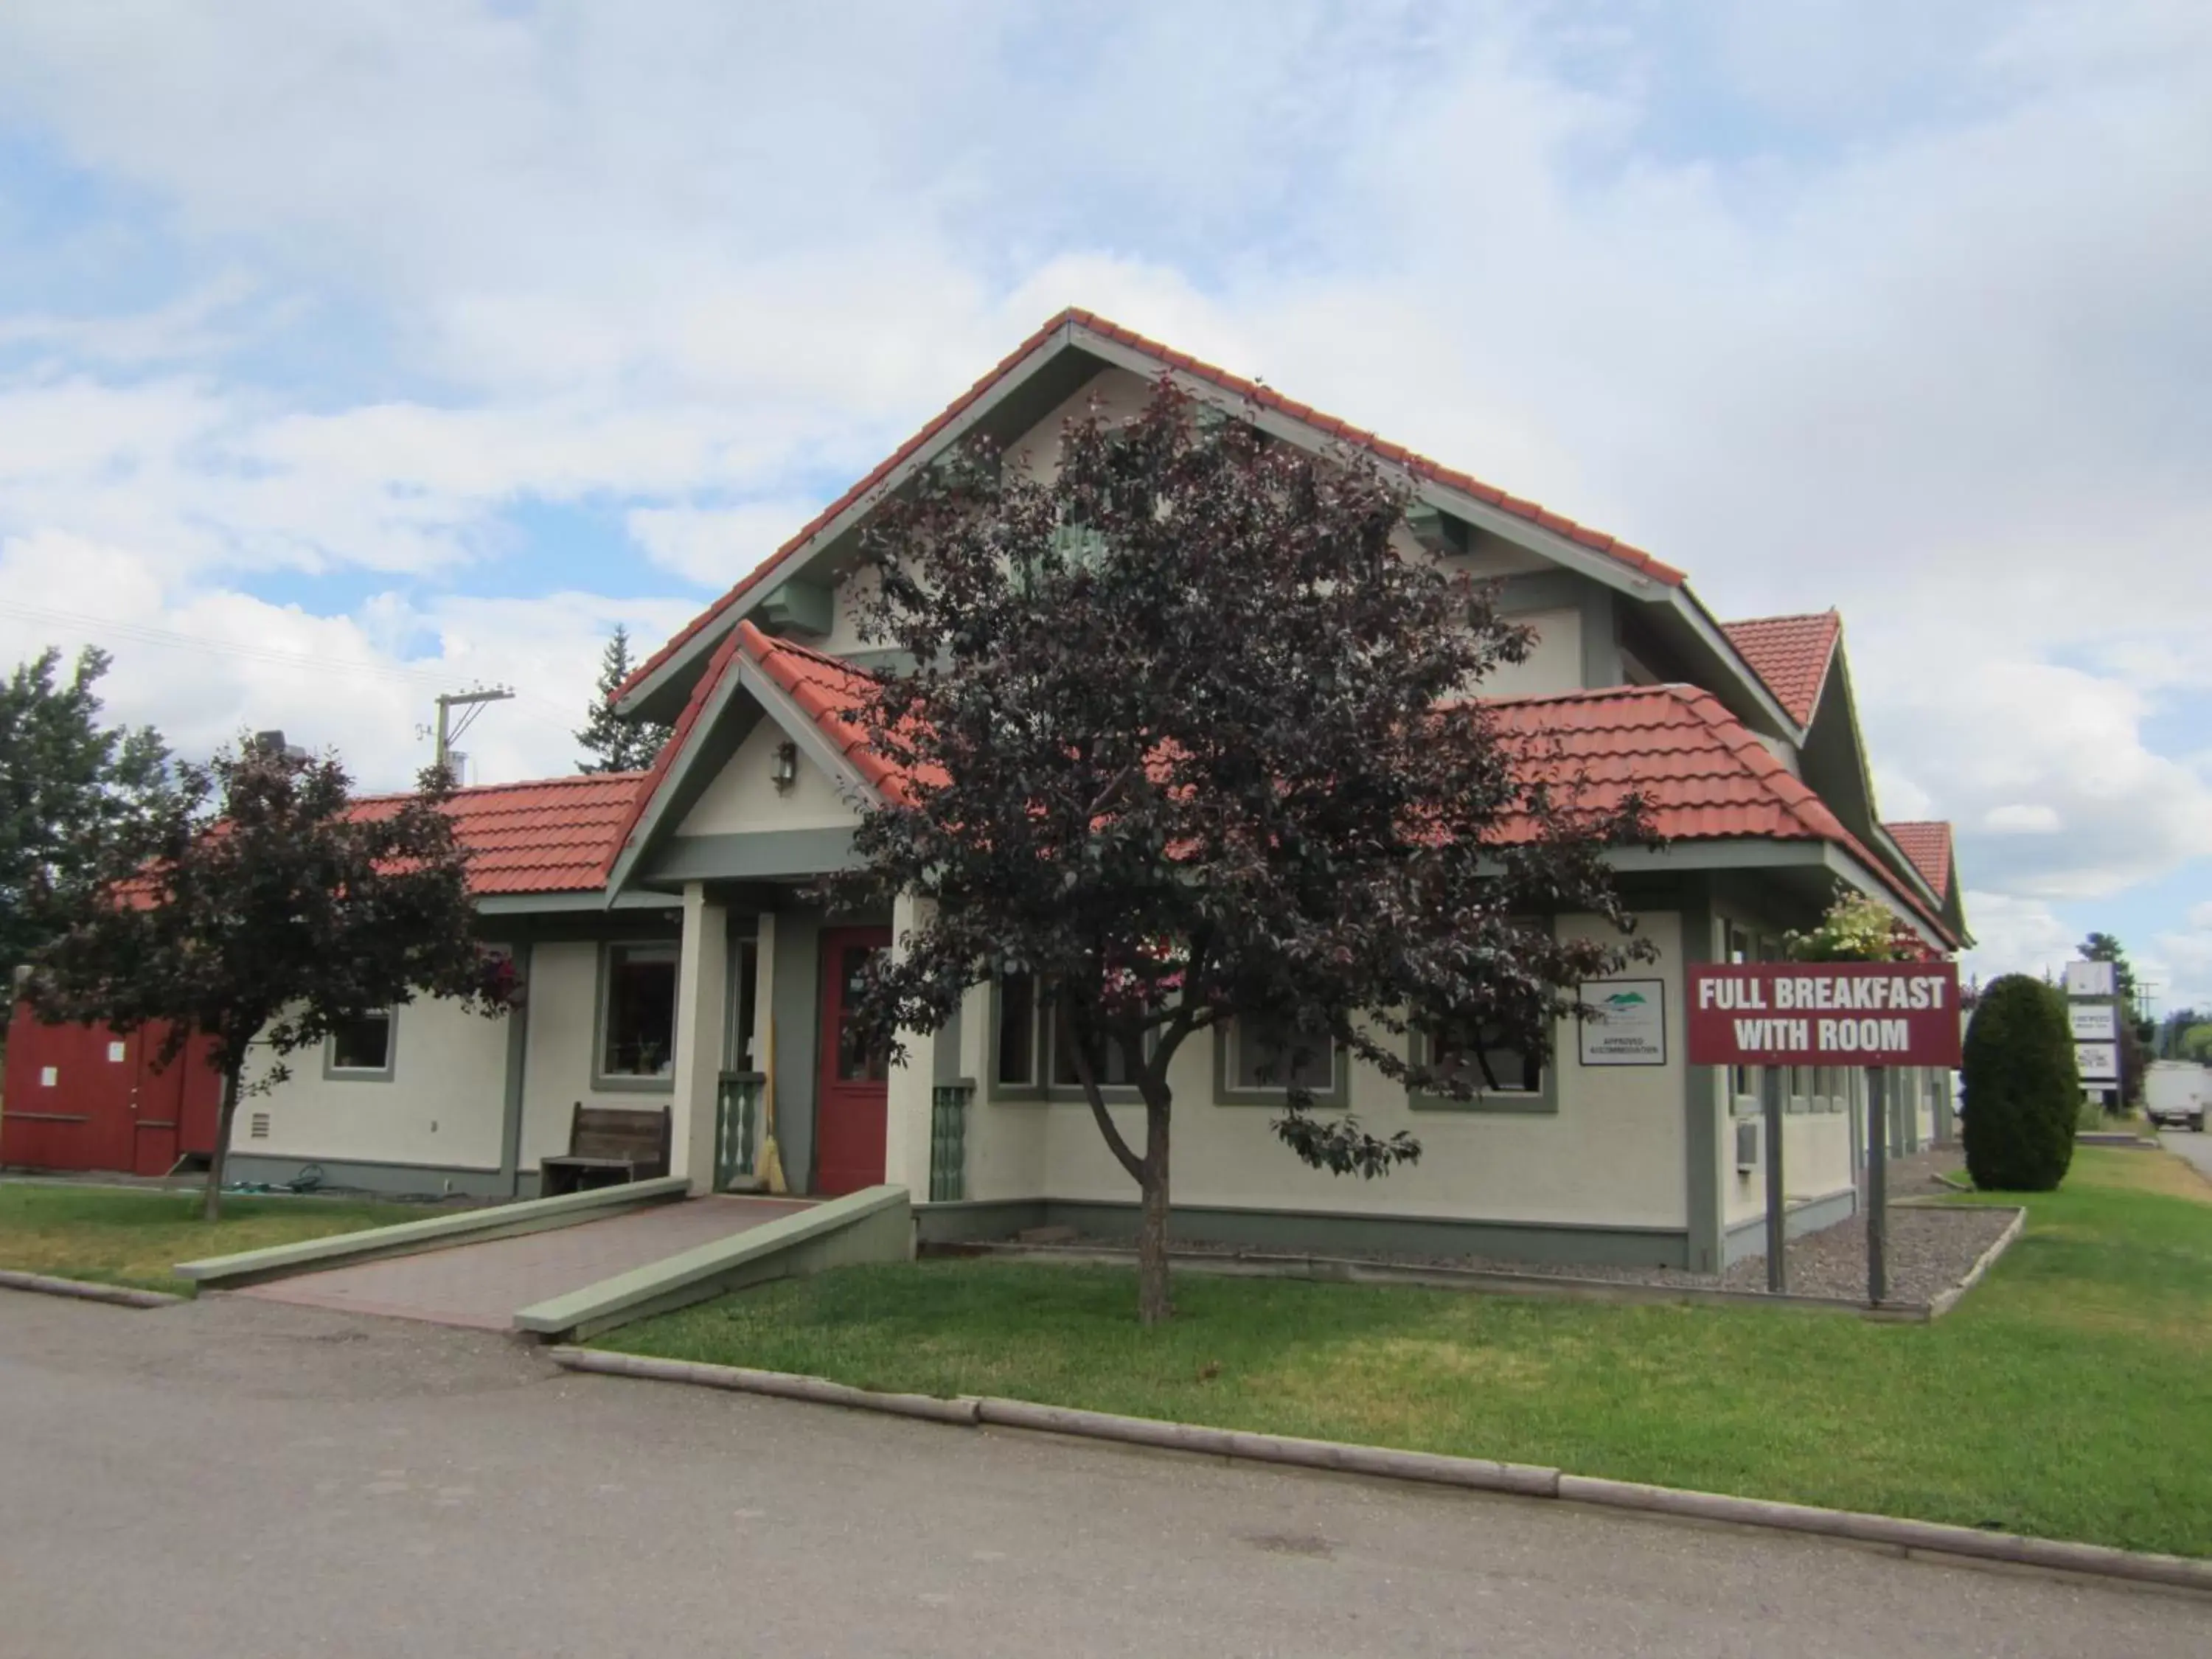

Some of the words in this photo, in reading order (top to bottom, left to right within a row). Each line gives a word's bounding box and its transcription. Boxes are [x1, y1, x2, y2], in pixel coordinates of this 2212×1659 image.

[1699, 978, 1767, 1009] FULL
[1774, 977, 1946, 1009] BREAKFAST
[1734, 1019, 1808, 1051] WITH
[1818, 1019, 1909, 1051] ROOM
